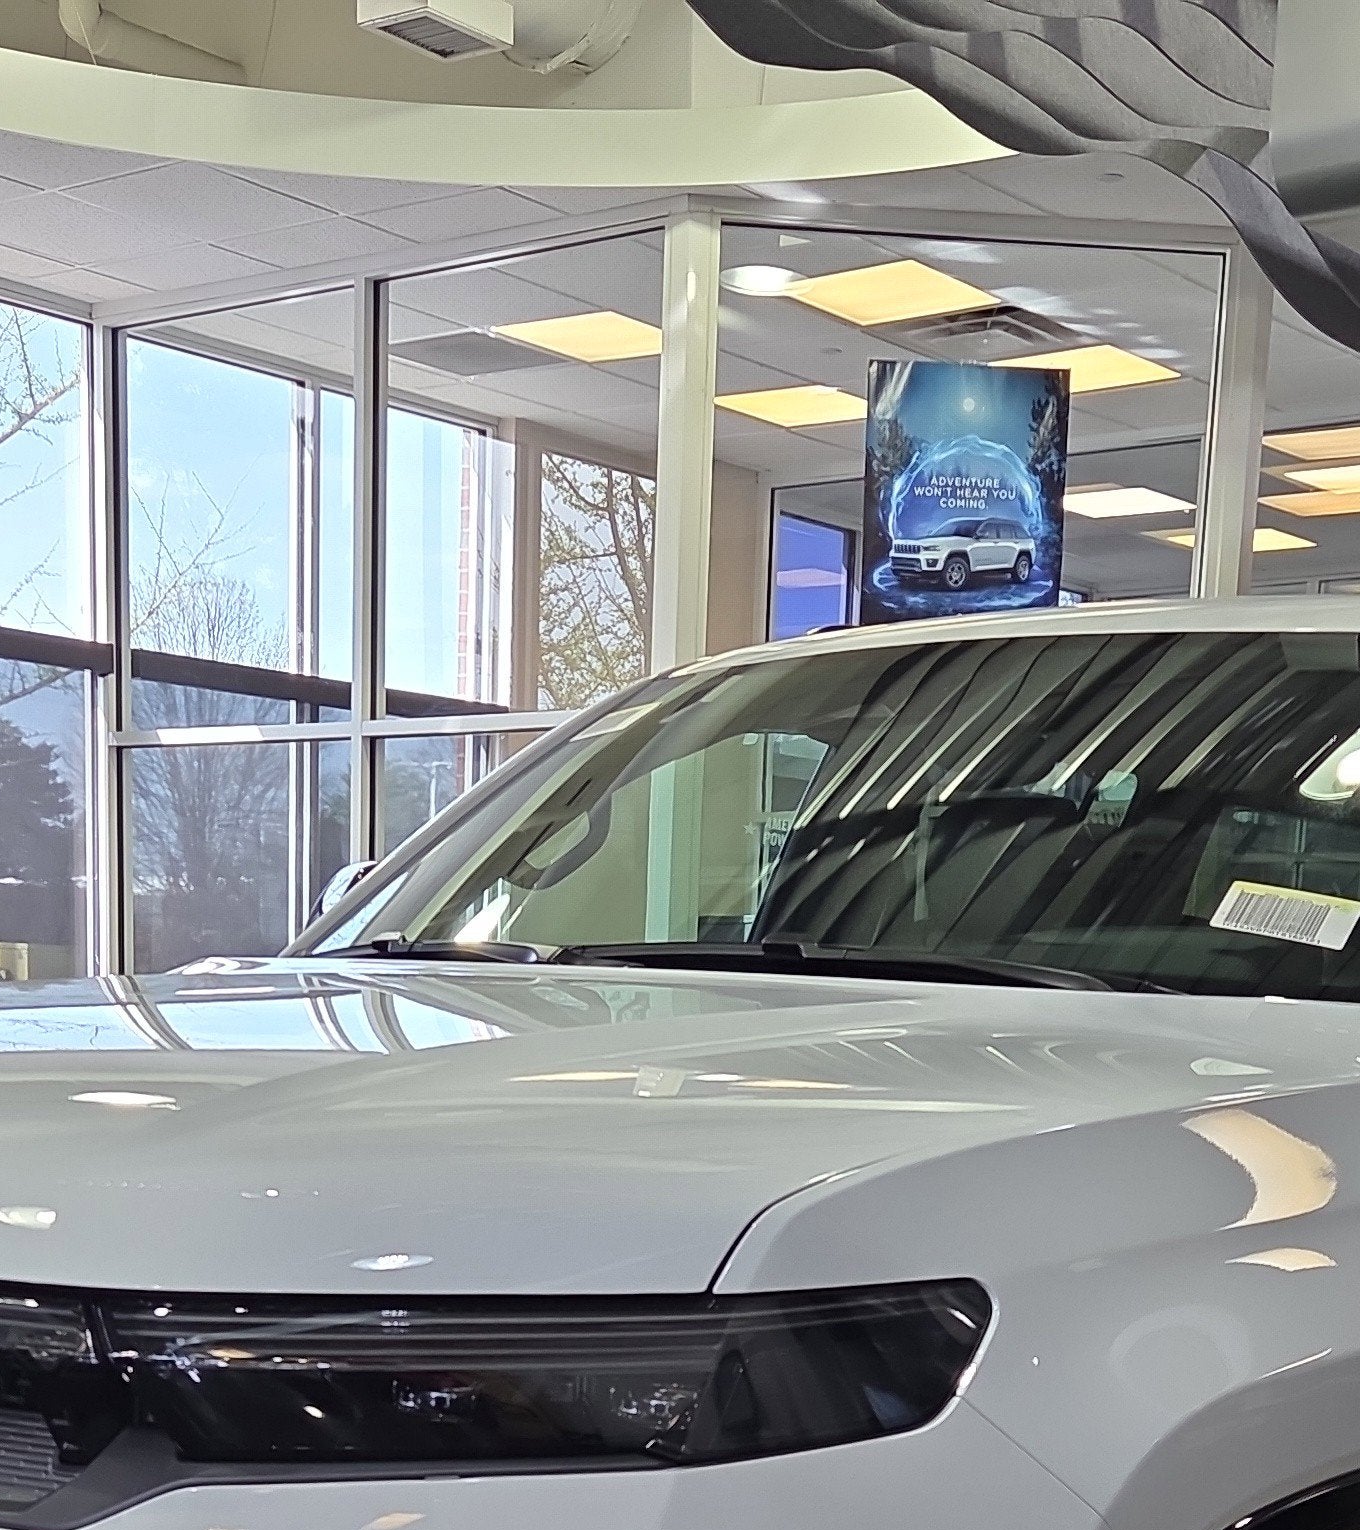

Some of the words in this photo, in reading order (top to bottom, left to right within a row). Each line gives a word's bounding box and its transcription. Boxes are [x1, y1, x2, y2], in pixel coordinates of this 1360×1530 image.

[930, 475, 1001, 489] ADVENTURE
[913, 486, 953, 498] WON'T
[956, 487, 988, 499] HEAR
[992, 489, 1017, 501] YOU
[939, 497, 989, 511] COMING.
